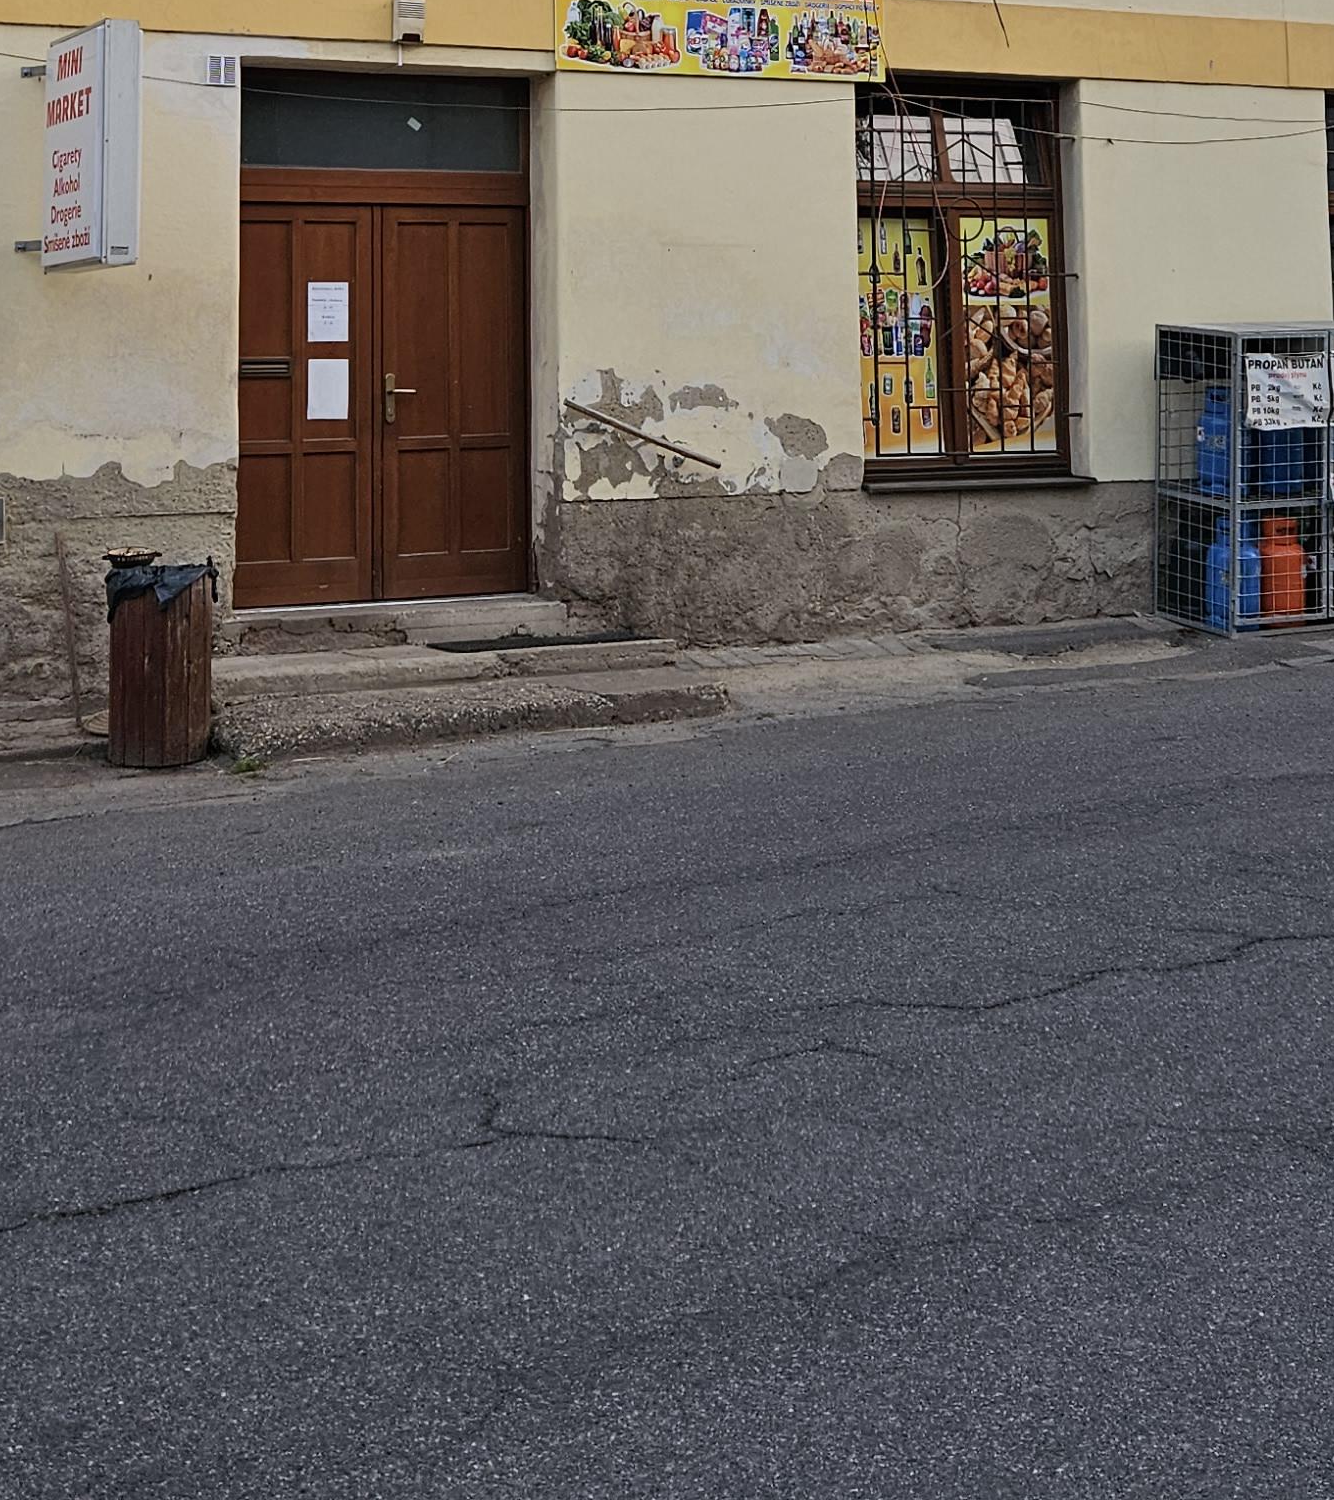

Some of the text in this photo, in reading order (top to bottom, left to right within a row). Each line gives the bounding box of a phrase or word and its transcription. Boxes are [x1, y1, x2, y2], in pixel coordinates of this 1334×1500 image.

[57, 46, 83, 81] MINI
[46, 87, 92, 128] MARKET
[52, 148, 82, 172] Cigarety
[53, 172, 80, 197] Alkohol
[51, 200, 81, 226] Drogerie
[71, 226, 90, 248] zboží
[1248, 358, 1324, 370] PROPAN BUTAN
